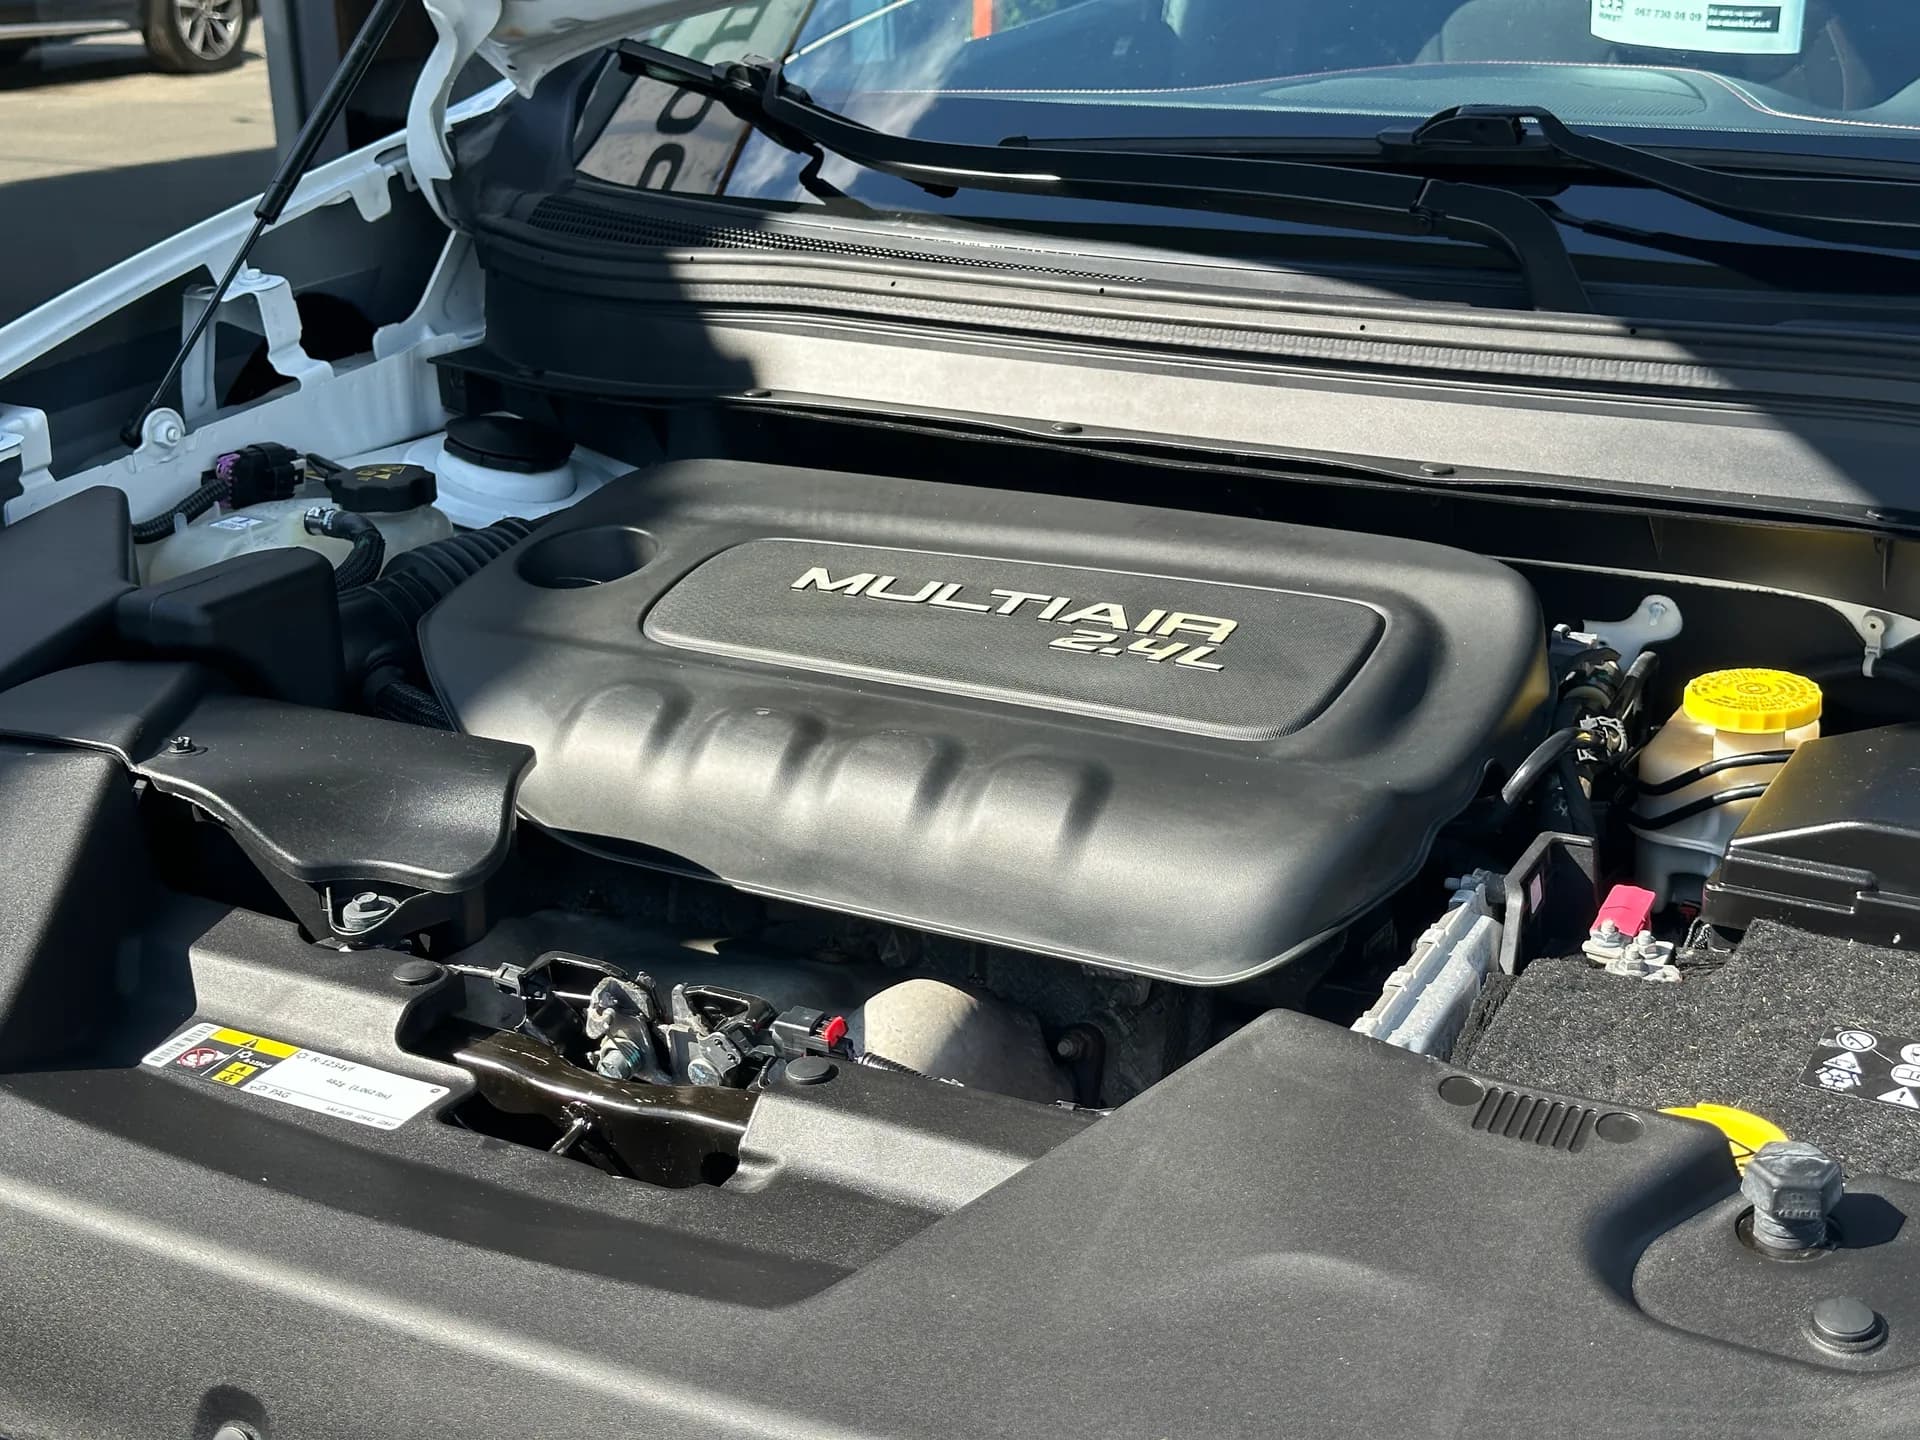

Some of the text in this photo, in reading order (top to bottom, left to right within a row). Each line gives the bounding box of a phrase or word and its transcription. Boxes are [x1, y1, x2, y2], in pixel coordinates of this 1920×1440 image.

[790, 566, 1239, 645] MULTIAIR
[1048, 629, 1225, 671] 2.4L
[269, 1088, 291, 1099] PAG
